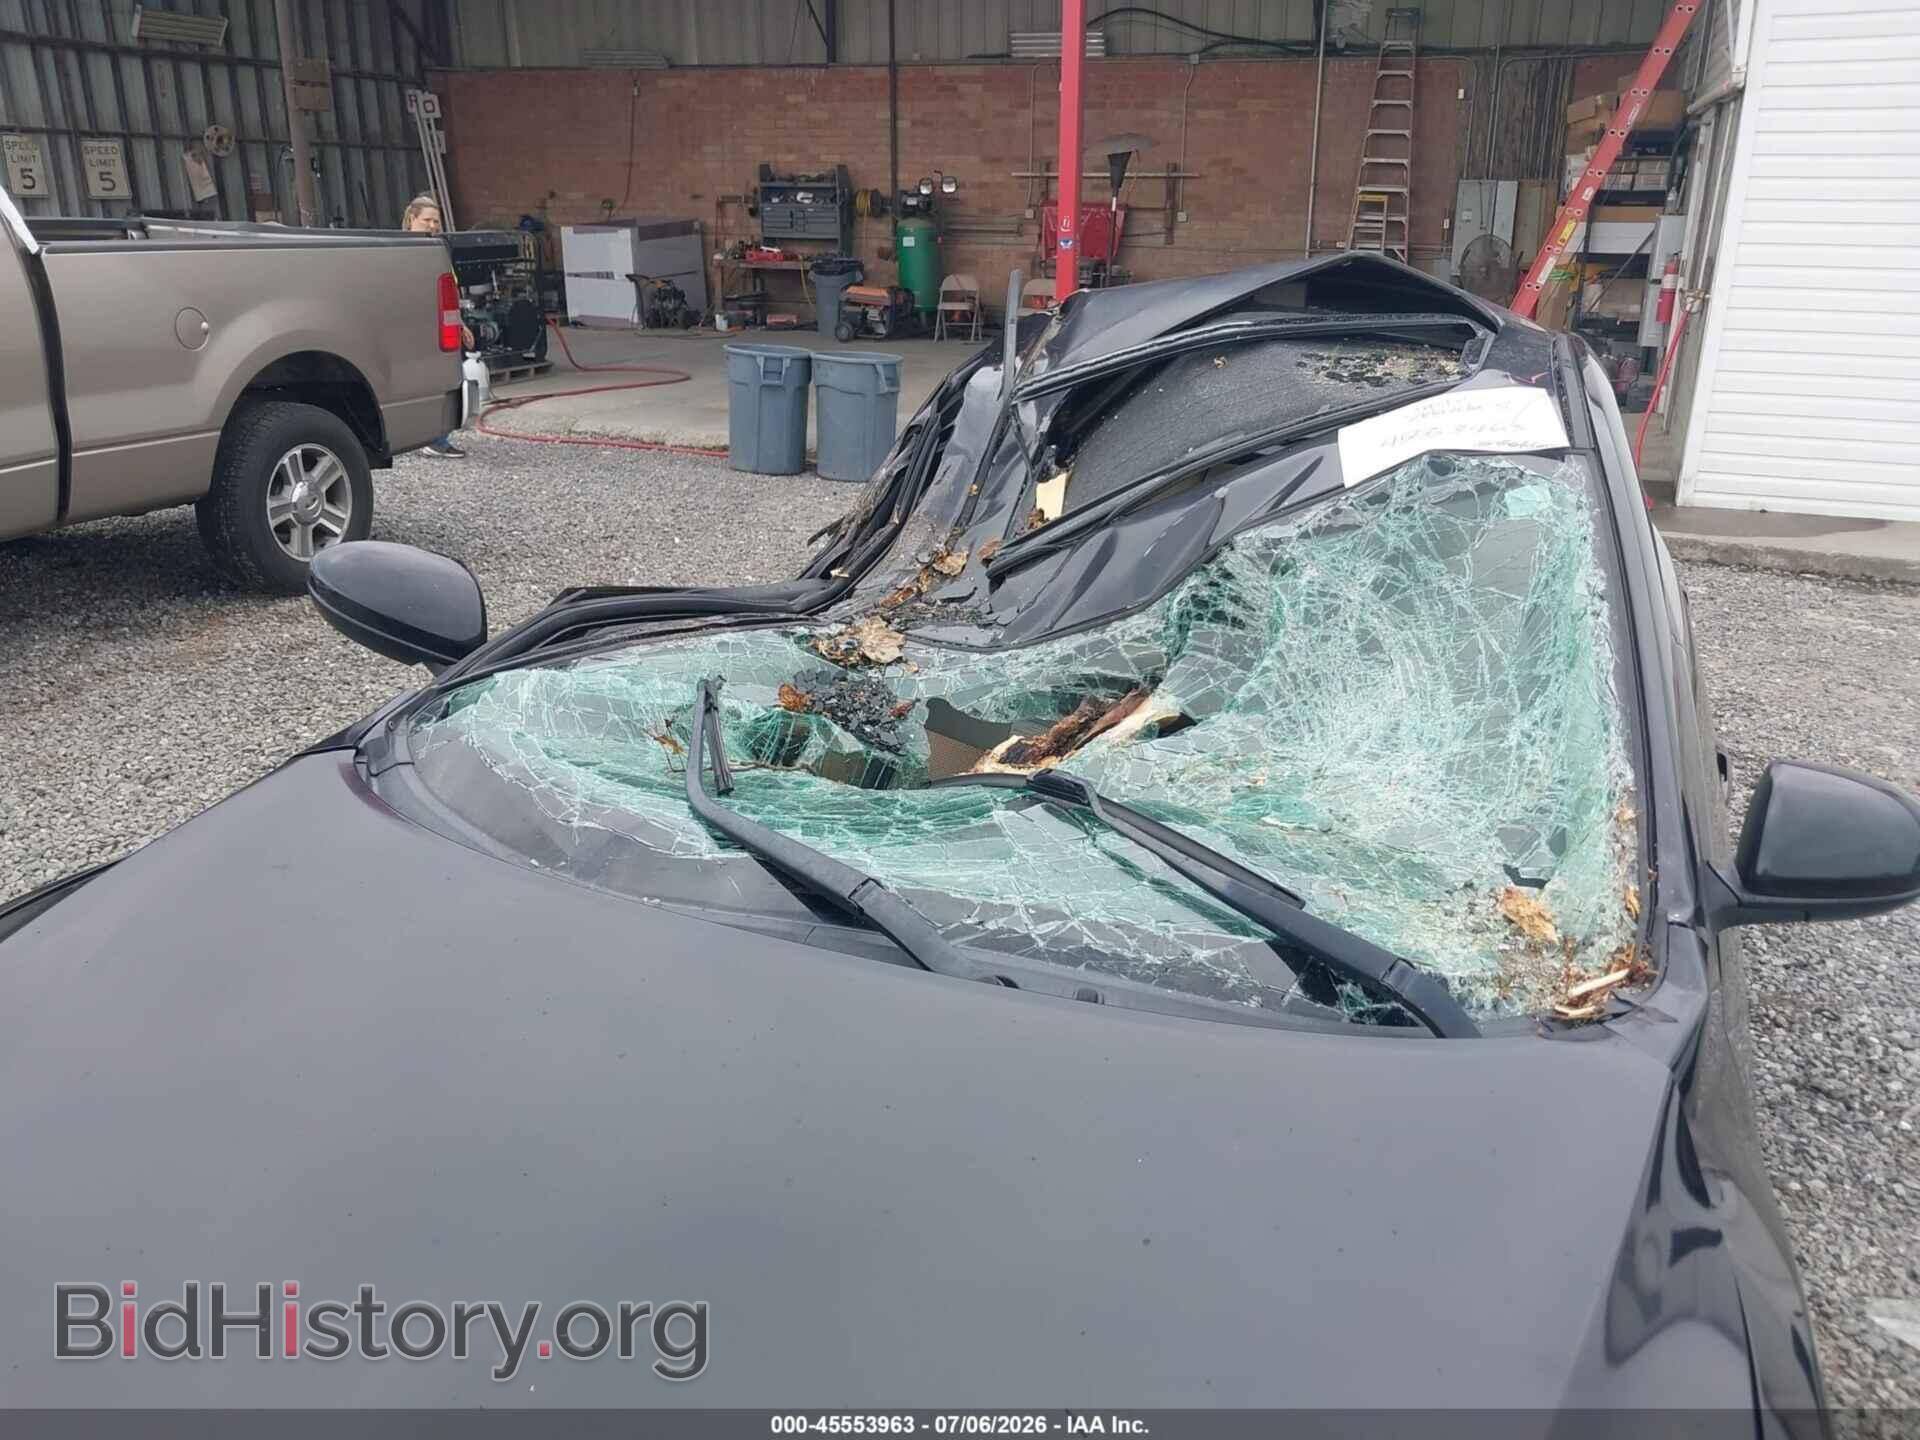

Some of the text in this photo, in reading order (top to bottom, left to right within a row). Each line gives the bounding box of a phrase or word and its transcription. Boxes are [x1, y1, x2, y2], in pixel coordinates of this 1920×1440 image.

[5, 140, 39, 151] SPEED
[83, 145, 119, 155] SPEED
[10, 154, 37, 163] LIMIT
[89, 158, 117, 168] LIMIT
[20, 167, 36, 190] 5
[98, 171, 116, 192] 5
